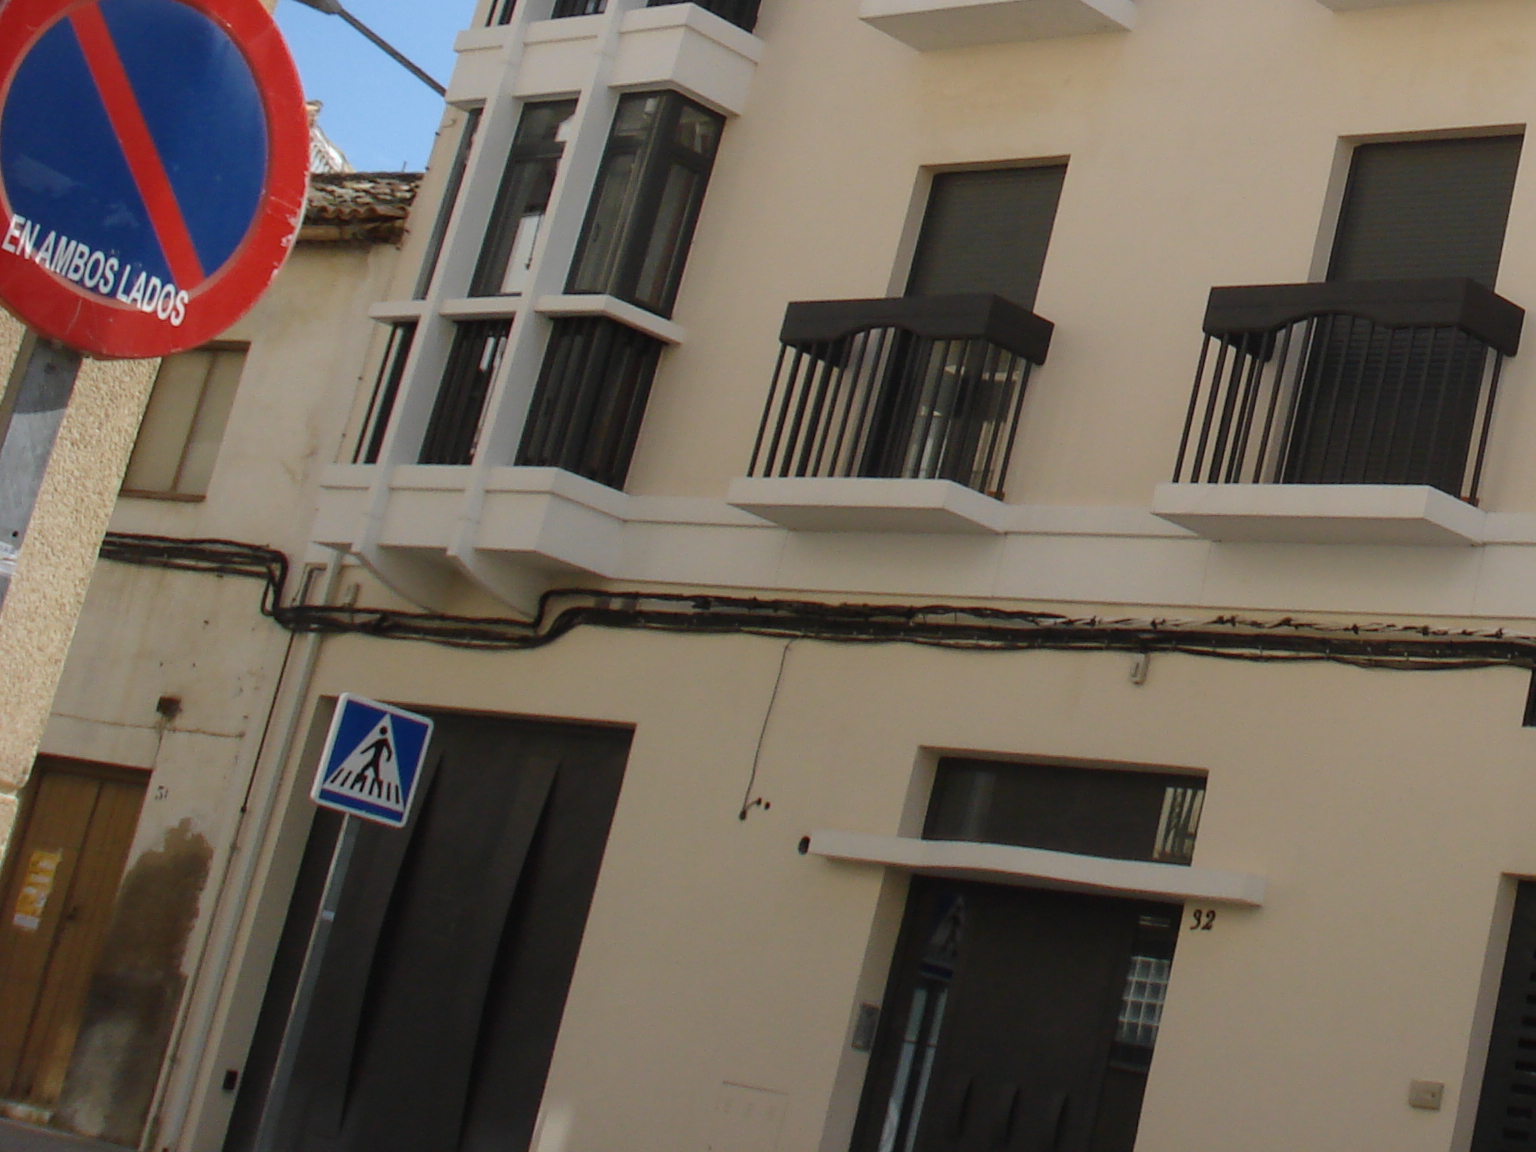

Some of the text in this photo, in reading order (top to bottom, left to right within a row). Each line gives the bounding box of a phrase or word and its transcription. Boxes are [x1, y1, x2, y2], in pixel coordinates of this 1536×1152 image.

[1, 213, 189, 326] EN AMBOS LADOS
